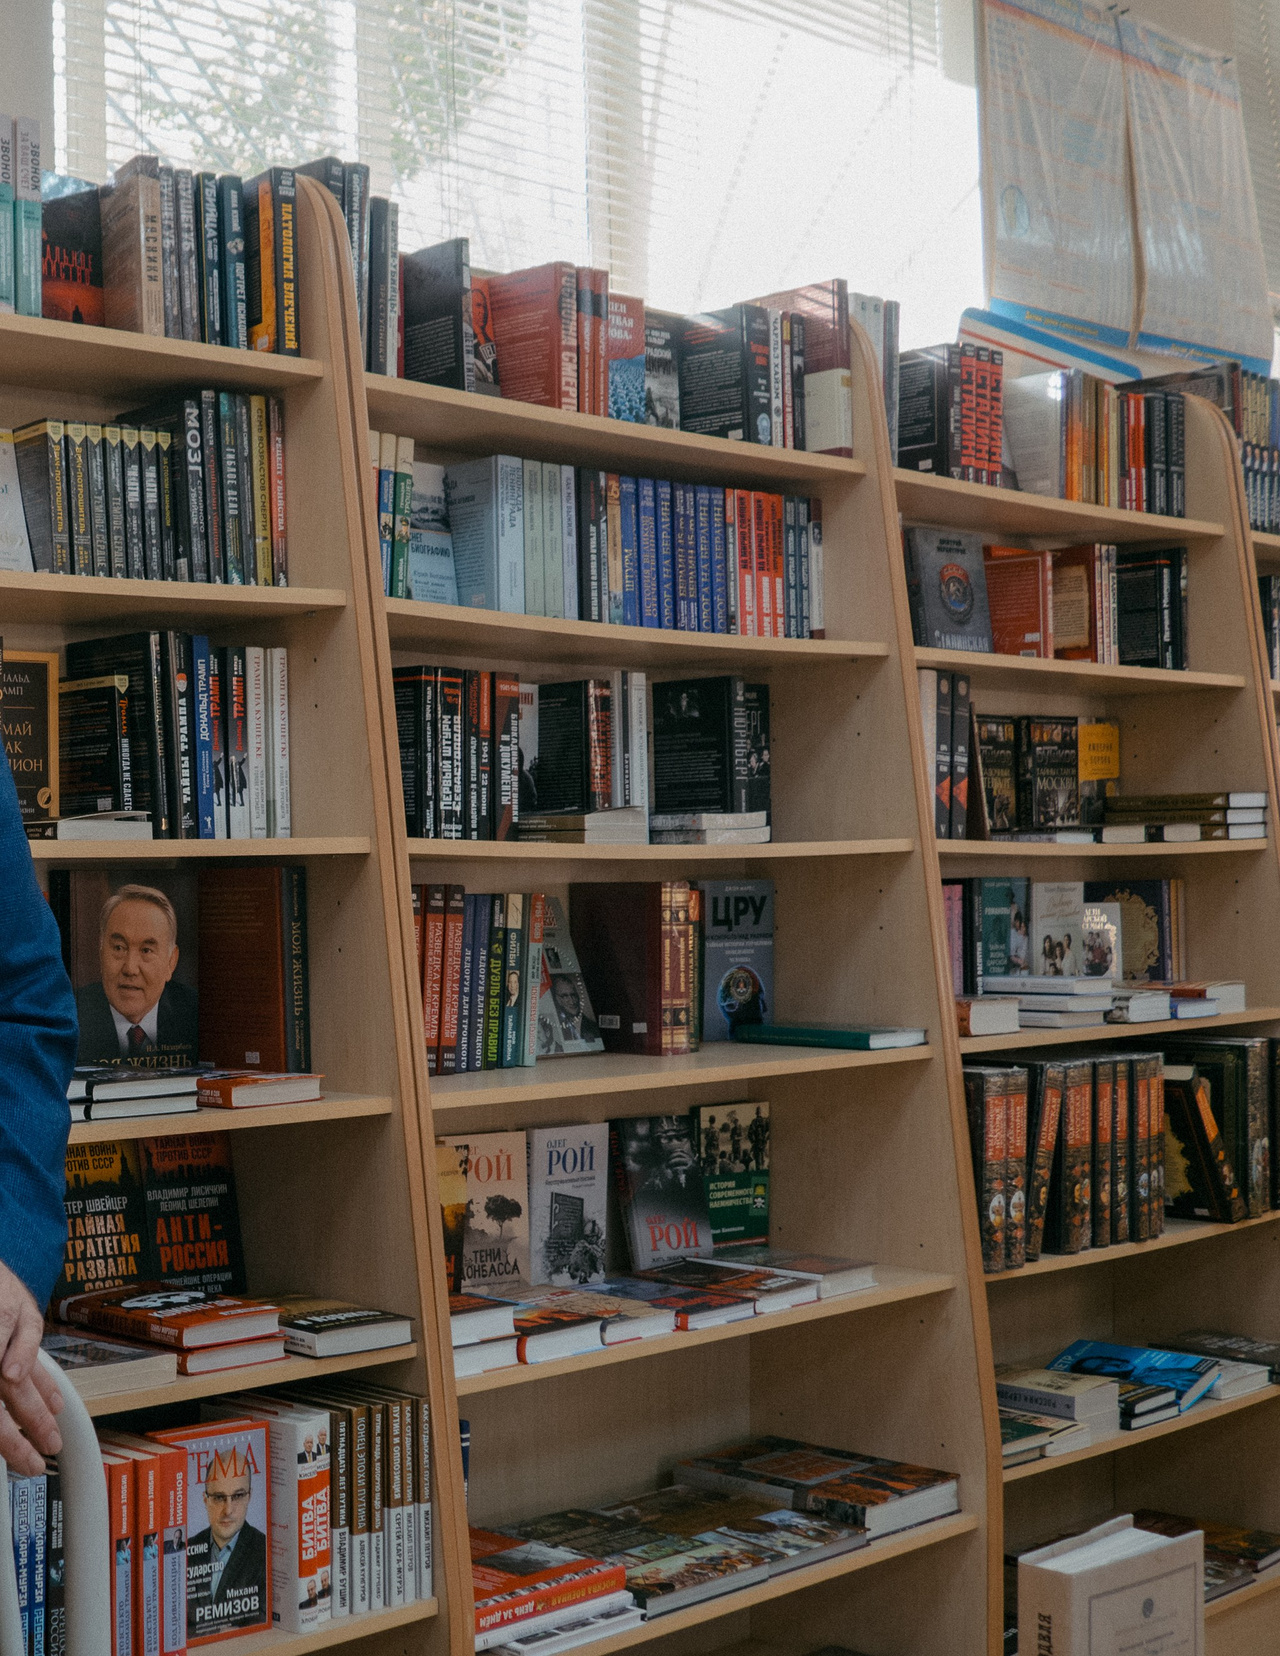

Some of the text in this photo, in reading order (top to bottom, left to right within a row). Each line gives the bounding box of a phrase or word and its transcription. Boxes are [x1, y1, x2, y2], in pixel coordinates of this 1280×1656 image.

[30, 142, 41, 192] ЗВОНОК
[205, 179, 218, 239] УБИЙЦА
[146, 215, 158, 282] МЯСНИКИ
[282, 203, 298, 349] ПАТОЛОГИЯ ВЛЕЧЕНИЙ
[186, 407, 203, 478] МОЗГ
[256, 407, 268, 532] СЕМЬ ВОЗРАСТОВ СМЕРТИ
[661, 500, 671, 555] БЕРЛИН
[699, 505, 710, 560] БЕРЛИН
[197, 658, 210, 741] ДОНАЛЬД ТРАМП
[178, 697, 191, 804] ТАЙНЫ ТРАМПА
[440, 714, 453, 811] ПЕРВЫЙ ШТУРМ
[481, 740, 489, 764] 1941
[733, 706, 748, 783] НЮРНБЕРГ
[712, 894, 768, 932] ЦРУ
[509, 931, 518, 967] ФИЛБИ
[291, 921, 304, 1017] МОЯ ЖИЗНЬ
[463, 948, 472, 993] ЛЕДОРУБ
[489, 958, 503, 997] ДУЭЛЬ
[460, 1018, 469, 1069] ТРОЦКОГО
[487, 1019, 500, 1062] ПРАВИЛ
[154, 1133, 216, 1148] ТАЙНАЯ ВОЙНА
[157, 1147, 213, 1162] ПРОТИВ СССР
[546, 1138, 567, 1149] ОЛЕГ
[546, 1142, 596, 1176] РОЙ
[65, 1157, 115, 1172] РОТИВ СССР
[147, 1184, 228, 1201] ВЛАДИМИР ЛИСИЧКИН
[160, 1196, 219, 1213] ЛЕОНИД ШЕЛЕПИН
[709, 1180, 736, 1191] ИСТОРИЯ
[709, 1187, 754, 1200] СОВРЕМЕННОГО
[709, 1196, 753, 1209] НАЕМНИЧЕСТВА
[64, 1195, 128, 1215] ЕТЕР ШВЕЙЦЕР
[67, 1213, 126, 1238] ТАЙНАЯ
[156, 1213, 223, 1245] АНТИ-
[648, 1217, 701, 1252] РОЙ
[66, 1233, 141, 1260] ТРАТЕГИЯ
[159, 1239, 229, 1273] РОССИЯ
[472, 1248, 502, 1264] ТЕНИ
[65, 1256, 138, 1282] РАЗВАЛА
[187, 1442, 261, 1486] ТЕМА
[176, 1471, 184, 1525] НИКОНОВ
[302, 1495, 315, 1561] БИТВА
[316, 1486, 328, 1552] БИТВА
[18, 1487, 28, 1608] СЕРГЕЙ КАРА-МУРЗА
[34, 1483, 45, 1604] СЕРГЕЙ КАРА-МУРЗА
[195, 1595, 260, 1622] РЕМИЗОВ
[226, 1585, 259, 1598] Михаил
[479, 1600, 536, 1629] ДЕНЬ ЗА ДНЁМ
